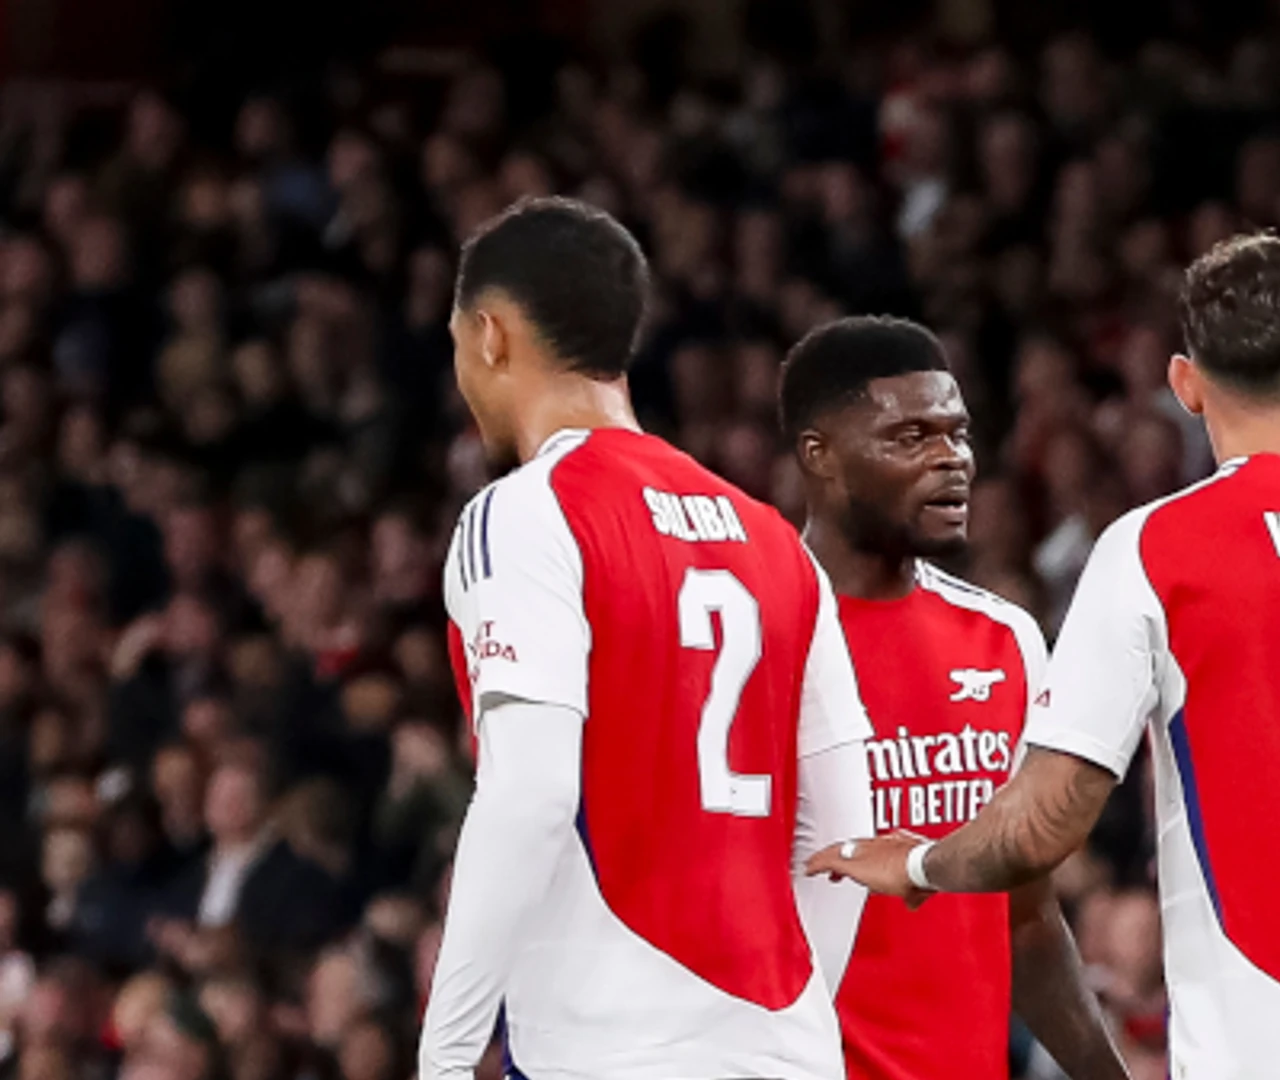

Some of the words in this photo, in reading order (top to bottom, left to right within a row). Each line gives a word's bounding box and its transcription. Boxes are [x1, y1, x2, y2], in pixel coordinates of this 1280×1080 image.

[677, 566, 772, 818] 2
[864, 723, 1011, 781] mirates
[872, 785, 902, 831] LY
